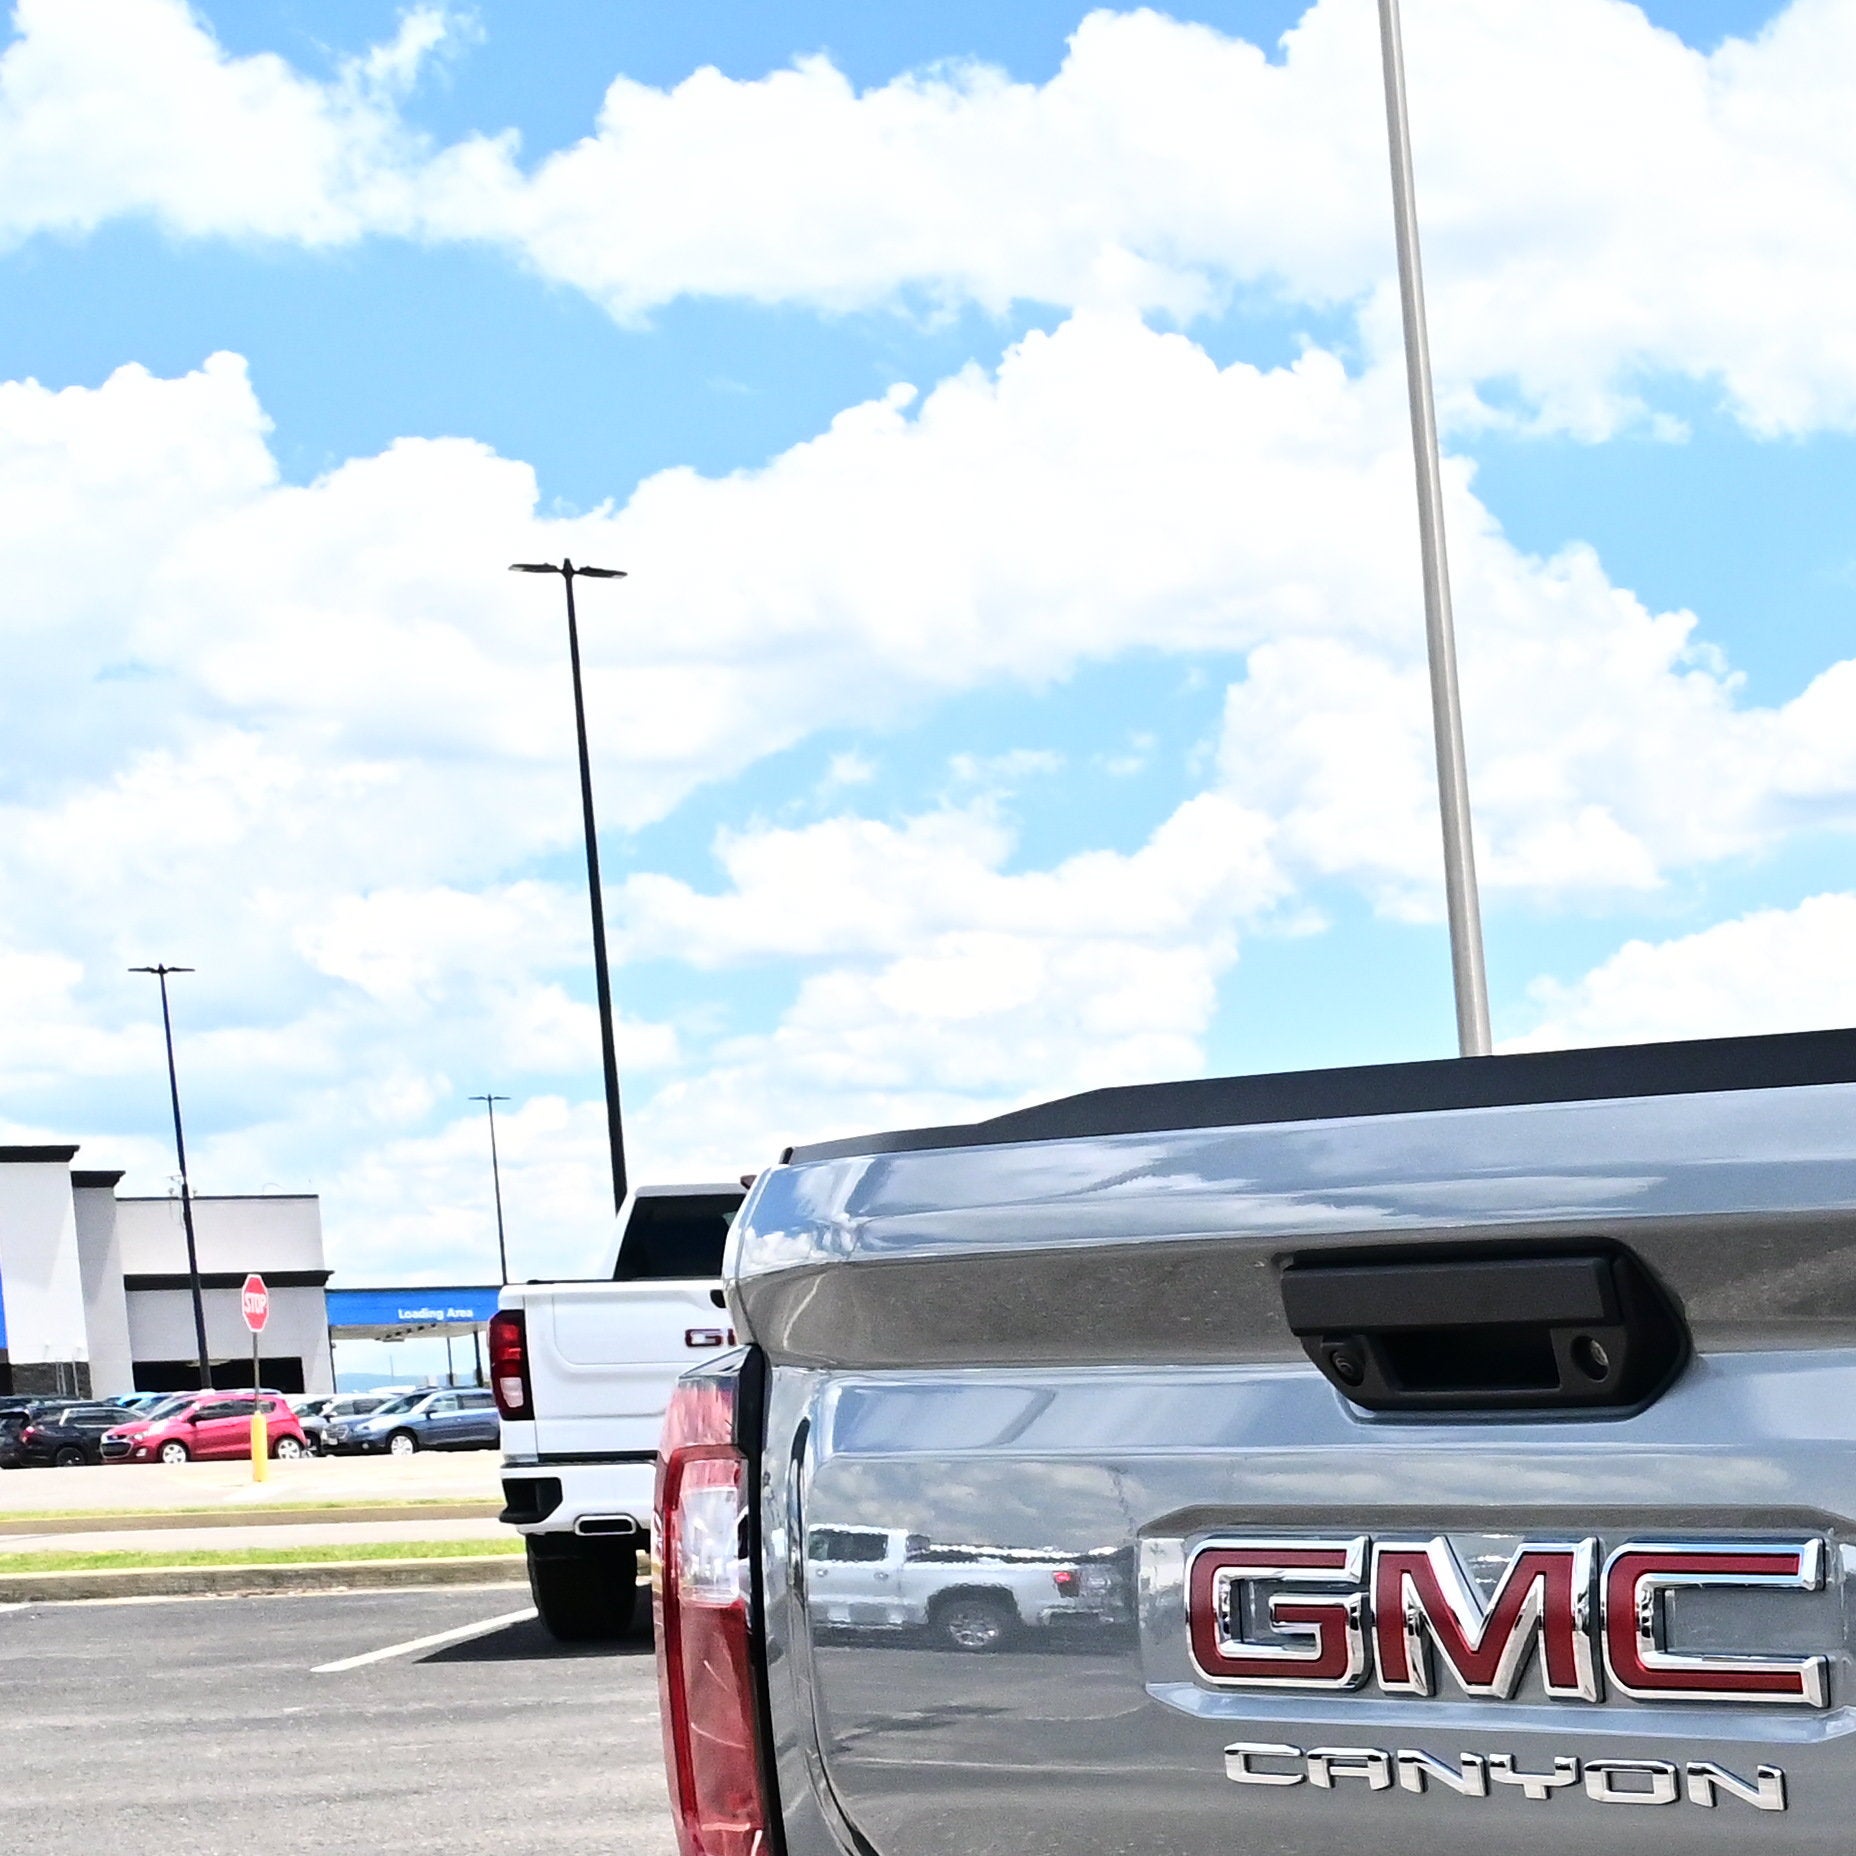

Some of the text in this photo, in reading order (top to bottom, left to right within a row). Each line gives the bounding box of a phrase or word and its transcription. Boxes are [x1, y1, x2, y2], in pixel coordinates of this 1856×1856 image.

[244, 1292, 267, 1315] STOP
[398, 1308, 474, 1321] Loading Area
[1183, 1534, 1830, 1708] GMC
[1224, 1742, 1788, 1811] CANYON
